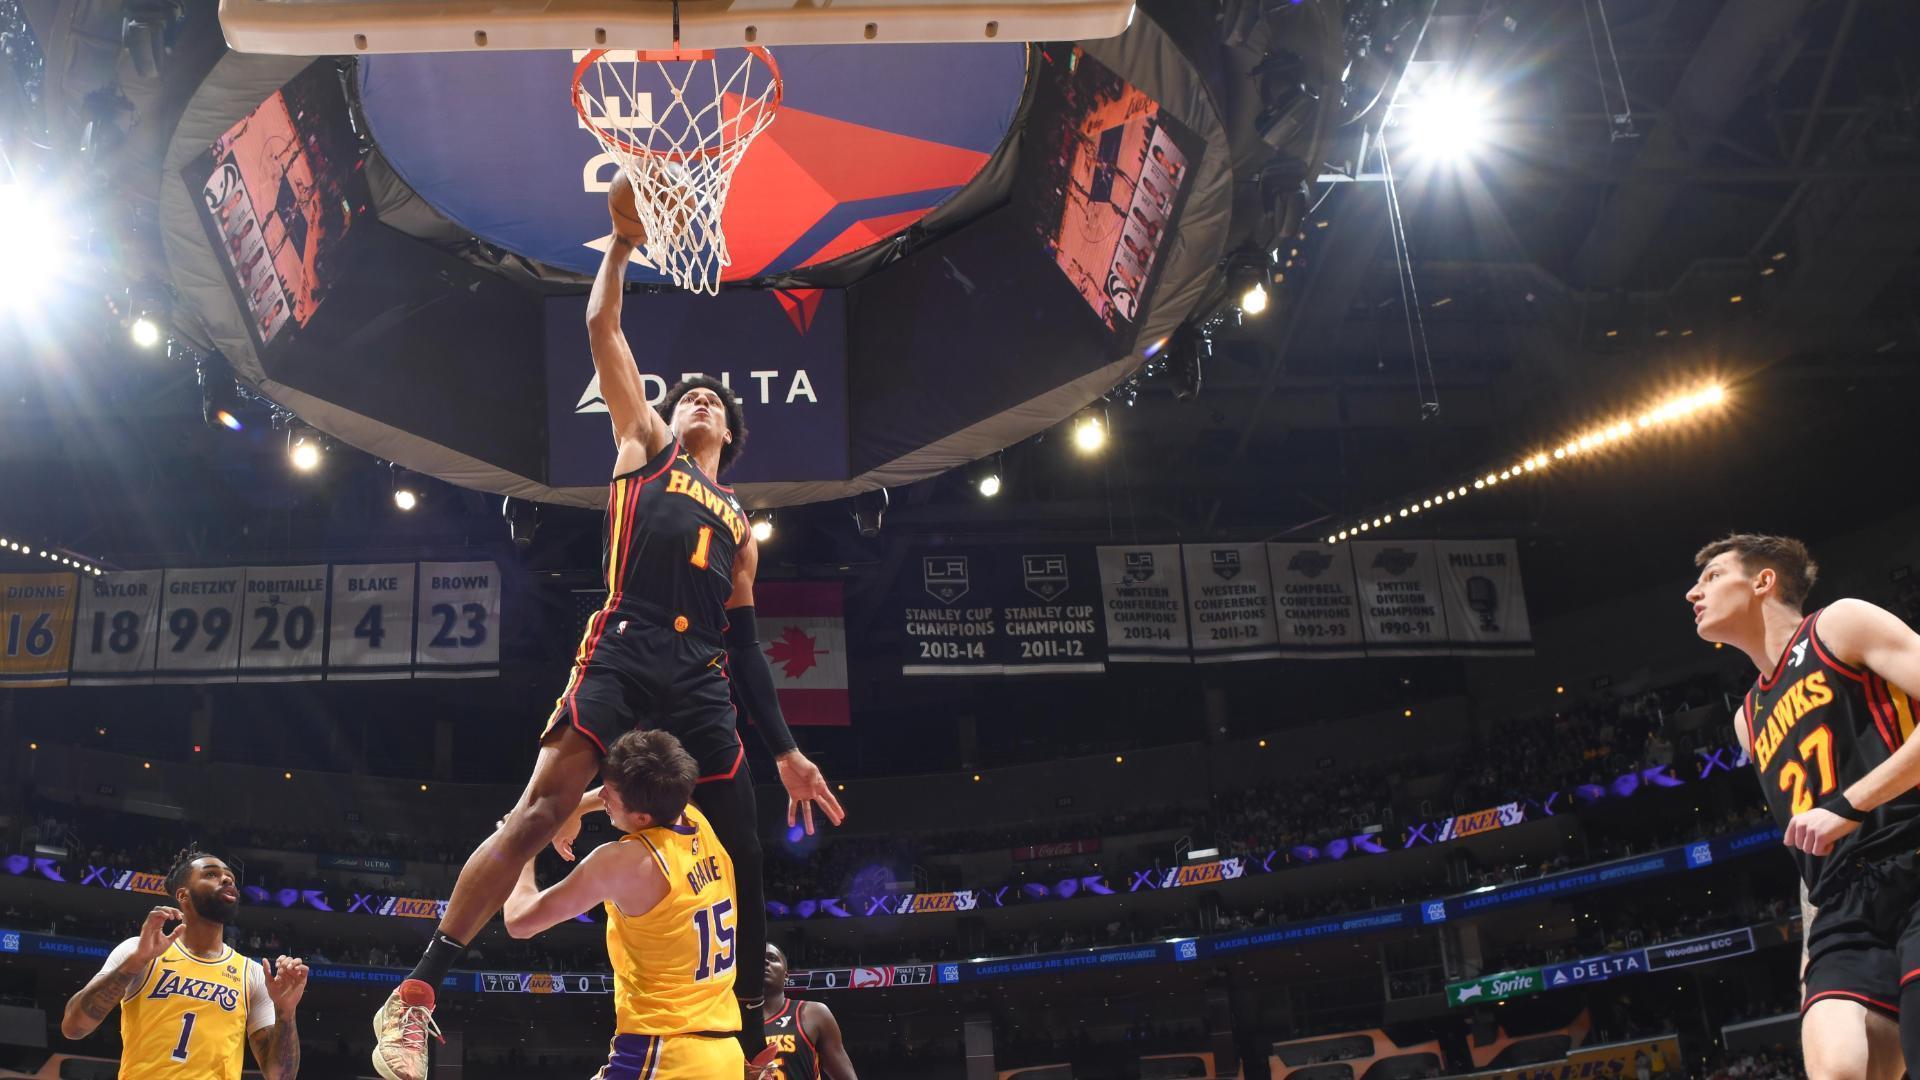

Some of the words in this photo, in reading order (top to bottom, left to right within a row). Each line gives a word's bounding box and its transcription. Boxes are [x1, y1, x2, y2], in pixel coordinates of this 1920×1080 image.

[642, 369, 818, 404] DLTA
[666, 469, 746, 545] HAWKS
[689, 525, 713, 570] 1
[1027, 560, 1063, 574] LA
[1448, 553, 1506, 567] MILLER
[928, 562, 964, 576] LA
[170, 580, 237, 595] GRETZKY
[248, 578, 323, 593] ROBITAILLE
[348, 577, 397, 591] BLAKE
[432, 576, 488, 590] BROWN
[1285, 584, 1343, 594] CAMPBELL
[1377, 581, 1420, 591] SMYTHE
[8, 585, 65, 599] DIONNE
[1201, 585, 1256, 596] WESTERN
[1109, 600, 1179, 610] CONFERENCE
[1194, 596, 1268, 610] CONFERENCE
[1280, 595, 1353, 607] CONFERENCE
[1376, 594, 1425, 604] DIVISION
[905, 608, 961, 620] STANLEY
[966, 608, 993, 620] CUP
[1005, 606, 1062, 620] STANLEY
[1066, 606, 1094, 618] CUP
[1114, 612, 1176, 623] CHAMPIONS
[1200, 609, 1266, 623] CHAMPIONS
[1285, 608, 1350, 619] CHAMPIONS
[1370, 606, 1435, 617] CHAMPIONS
[92, 610, 139, 654] 18
[169, 607, 232, 652] 99
[251, 605, 315, 650] 20
[354, 604, 385, 648] 4
[428, 603, 487, 648] 23
[906, 621, 995, 636] CHAMPIONS
[1005, 620, 1095, 635] CHAMPIONS
[1294, 624, 1345, 637] 1992-93
[1380, 621, 1430, 634] 1990-91
[7, 613, 54, 657] 16
[1124, 627, 1170, 640] 2013-14
[1211, 626, 1258, 640] 2011-12
[920, 641, 985, 658] 2013-14
[1021, 640, 1084, 658] 2011-12
[1754, 670, 1833, 774] HAWKS
[1779, 724, 1837, 817] 27
[1439, 801, 1524, 843] LAKERS
[364, 861, 390, 869] ULTRA
[1162, 857, 1245, 888] LAKERS
[114, 870, 170, 896] LAKE
[1464, 895, 1499, 910] LAKERS
[1502, 888, 1535, 901] GAMES
[1559, 873, 1597, 889] BETTER
[898, 890, 976, 914] LAKERS
[1428, 904, 1445, 913] AM
[693, 898, 736, 982] 15
[1215, 938, 1248, 950] LAKERS
[1251, 932, 1284, 944] GAMES
[1285, 929, 1302, 939] ARE
[1305, 923, 1340, 936] BETTER
[1711, 937, 1732, 949] ECC
[39, 941, 74, 953] LAKERS
[1181, 942, 1196, 950] AM
[944, 966, 959, 974] AM
[976, 966, 1010, 975] LAKERS
[1012, 961, 1043, 972] GAMES
[1045, 959, 1064, 968] ARE
[1065, 955, 1097, 966] BETTER
[1572, 956, 1639, 980] DELTA
[314, 970, 347, 979] GAMES
[350, 972, 366, 980] ARE
[368, 973, 401, 982] BETTER
[825, 973, 836, 987] 0
[901, 974, 907, 984] 0
[919, 974, 926, 984] 7
[147, 968, 239, 1011] LAKERS
[490, 981, 497, 990] 7
[507, 981, 514, 990] 0
[578, 977, 589, 992] 0
[1490, 973, 1533, 998] Sprite
[172, 1012, 196, 1061] 1
